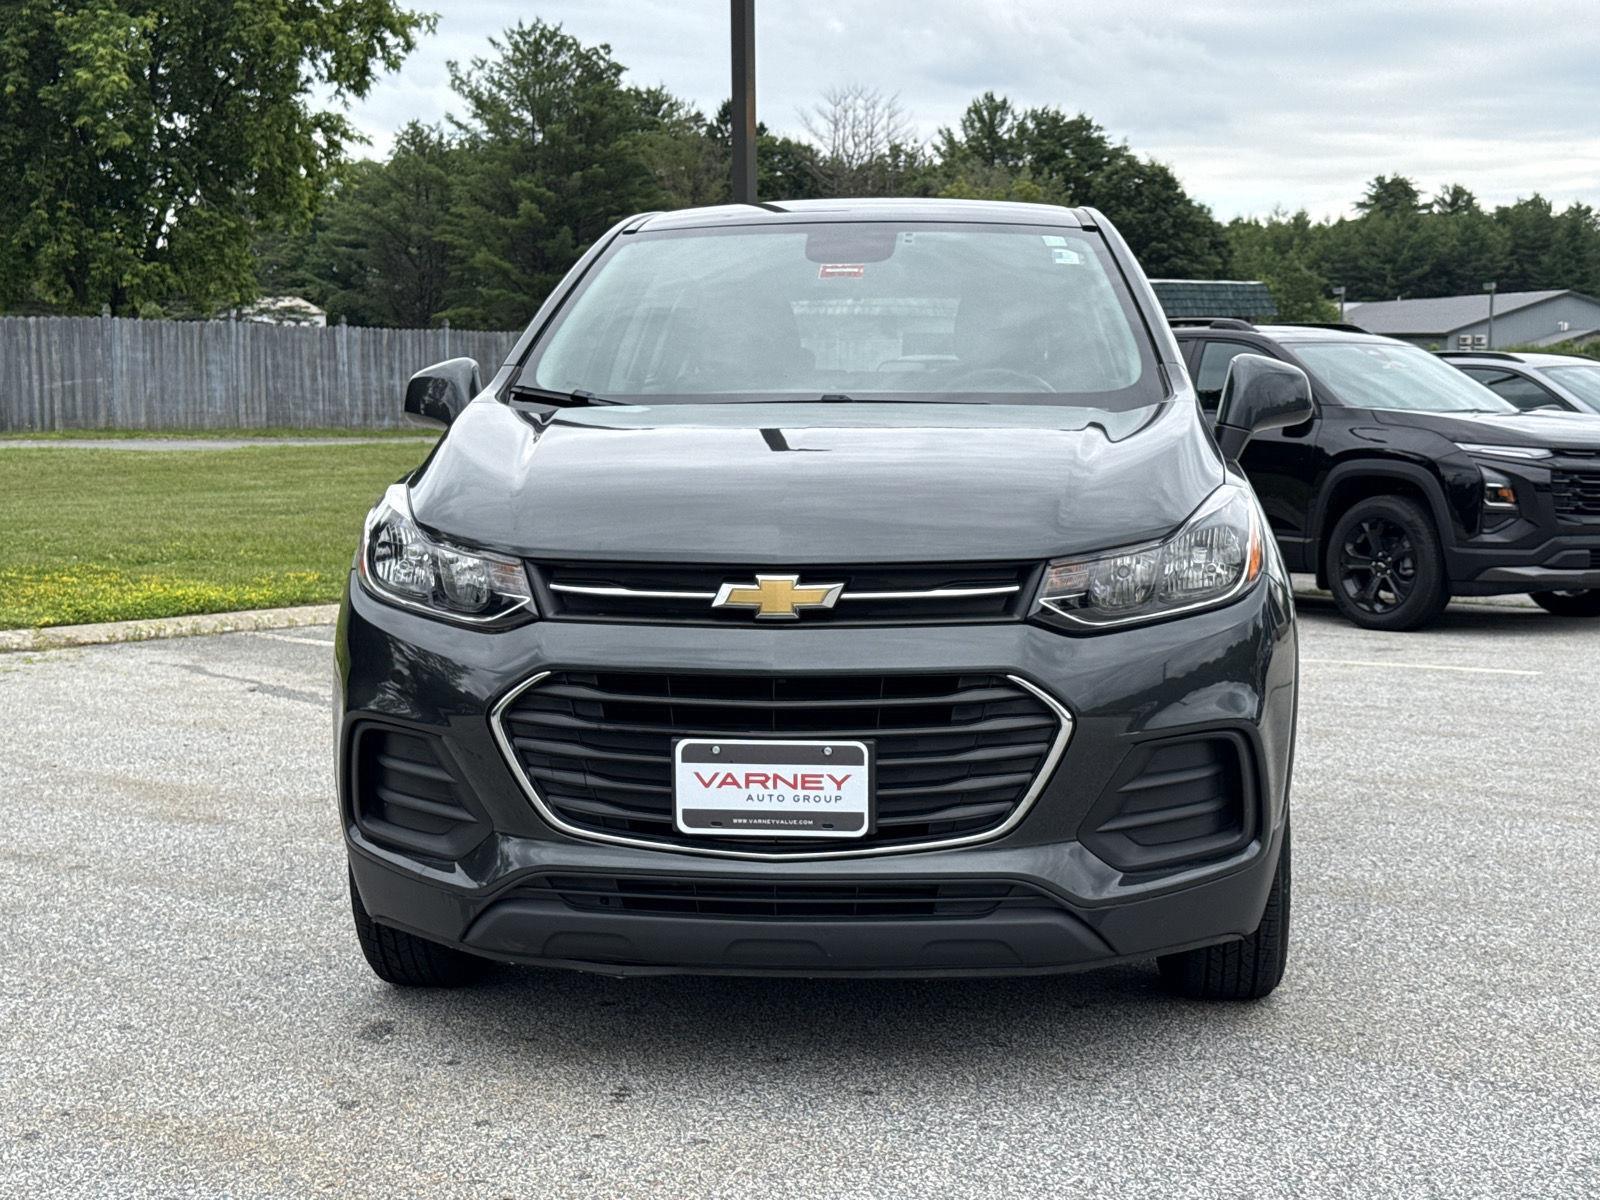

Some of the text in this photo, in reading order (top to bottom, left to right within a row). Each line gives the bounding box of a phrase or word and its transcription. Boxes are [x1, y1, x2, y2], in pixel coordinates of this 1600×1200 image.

[693, 771, 852, 791] VARNEY
[746, 794, 843, 804] AUTO GROUP
